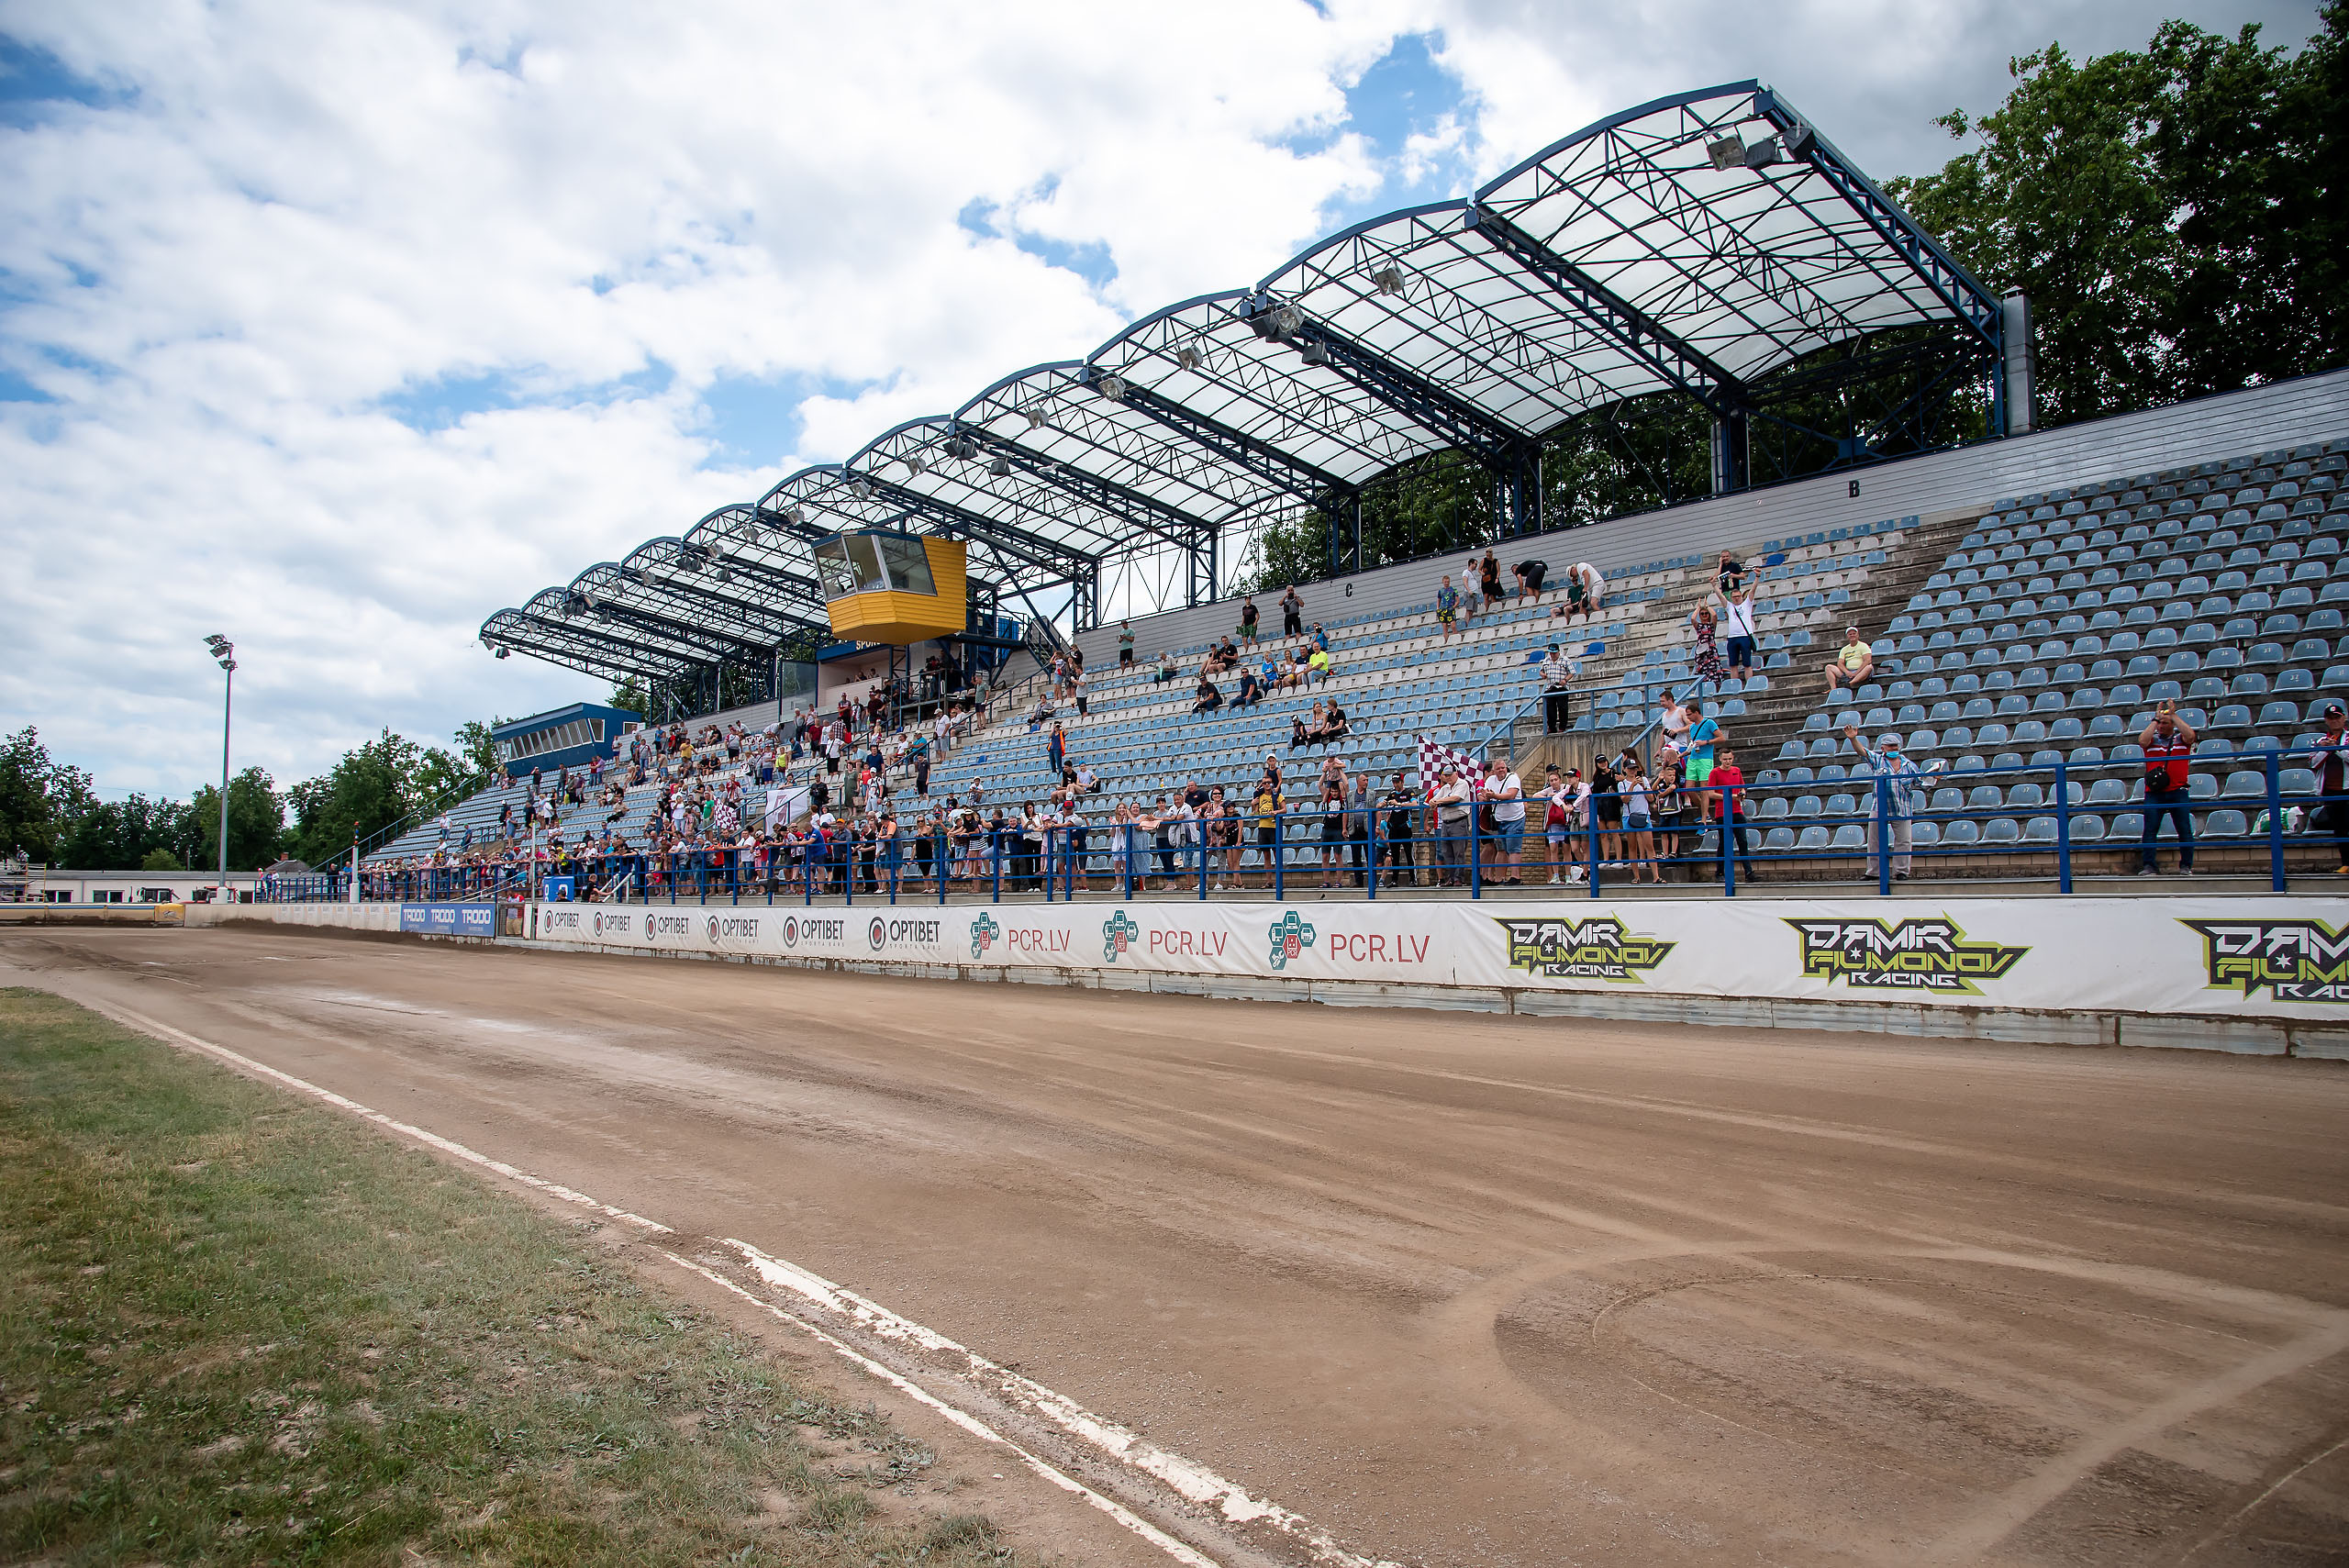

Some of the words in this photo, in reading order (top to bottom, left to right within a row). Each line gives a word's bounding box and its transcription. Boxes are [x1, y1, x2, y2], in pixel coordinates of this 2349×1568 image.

[1849, 480, 1860, 498] B
[1346, 583, 1353, 597] C
[403, 908, 426, 923] TRODO
[430, 908, 456, 924] TRODO
[462, 908, 492, 925] TRODO
[555, 912, 580, 928] OPTIBET
[605, 915, 631, 931] OPTIBET
[658, 917, 689, 934] OPTIBET
[722, 918, 759, 937] OPTIBET
[801, 919, 844, 940] OPTIBET
[889, 919, 941, 942] OPTIBET
[1008, 929, 1071, 951] PCR.LV
[1150, 929, 1228, 957] PCR.LV
[1507, 923, 1621, 950] DAMIR
[1800, 924, 1955, 956] DAMIR
[1330, 933, 1431, 963] PCR.LV
[1514, 945, 1665, 964] FILIMONOV
[1545, 963, 1626, 976] RACING
[1809, 950, 2014, 973] FILIMONOV
[2216, 957, 2349, 984] FILIM
[1851, 972, 1958, 986] RACING
